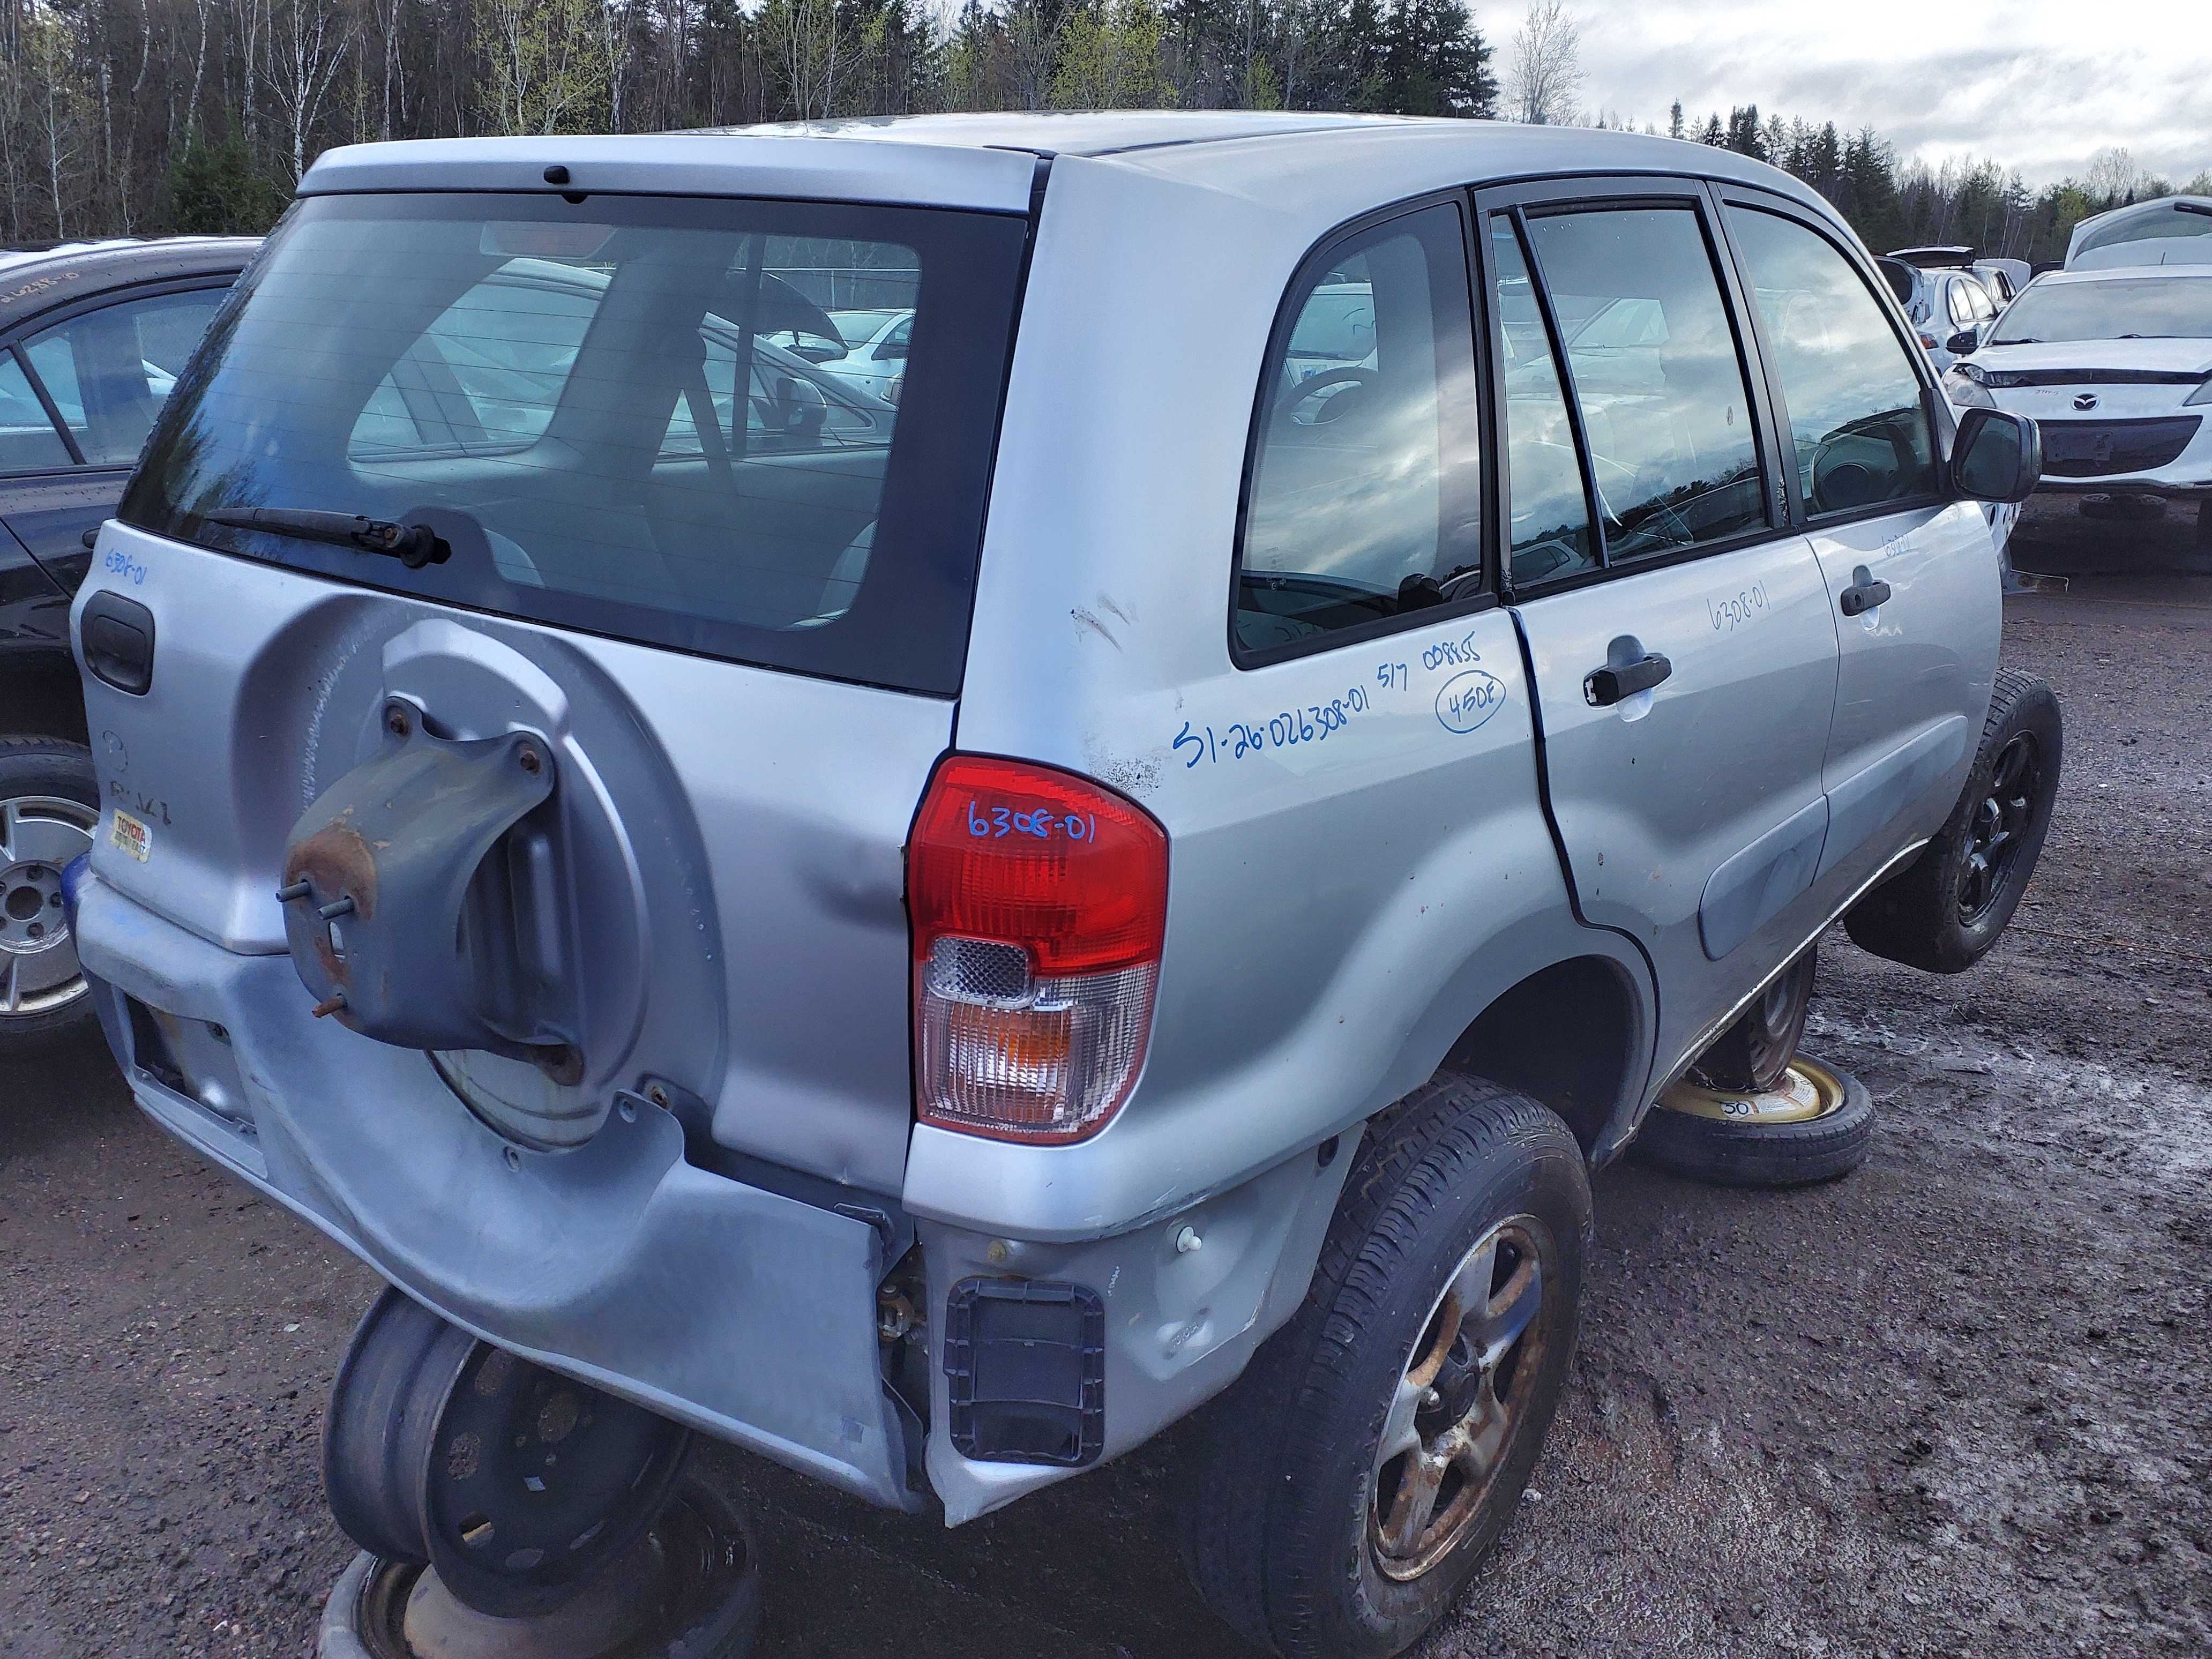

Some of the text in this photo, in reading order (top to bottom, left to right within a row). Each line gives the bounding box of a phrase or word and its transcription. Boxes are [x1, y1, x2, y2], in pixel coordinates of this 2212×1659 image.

[1707, 580, 1770, 631] 6308-01
[1377, 663, 1407, 692] 517
[1422, 630, 1481, 671] 008855
[117, 815, 146, 845] TOYOTA
[968, 801, 1095, 843] 6308-01
[1720, 1100, 1749, 1115] 50
